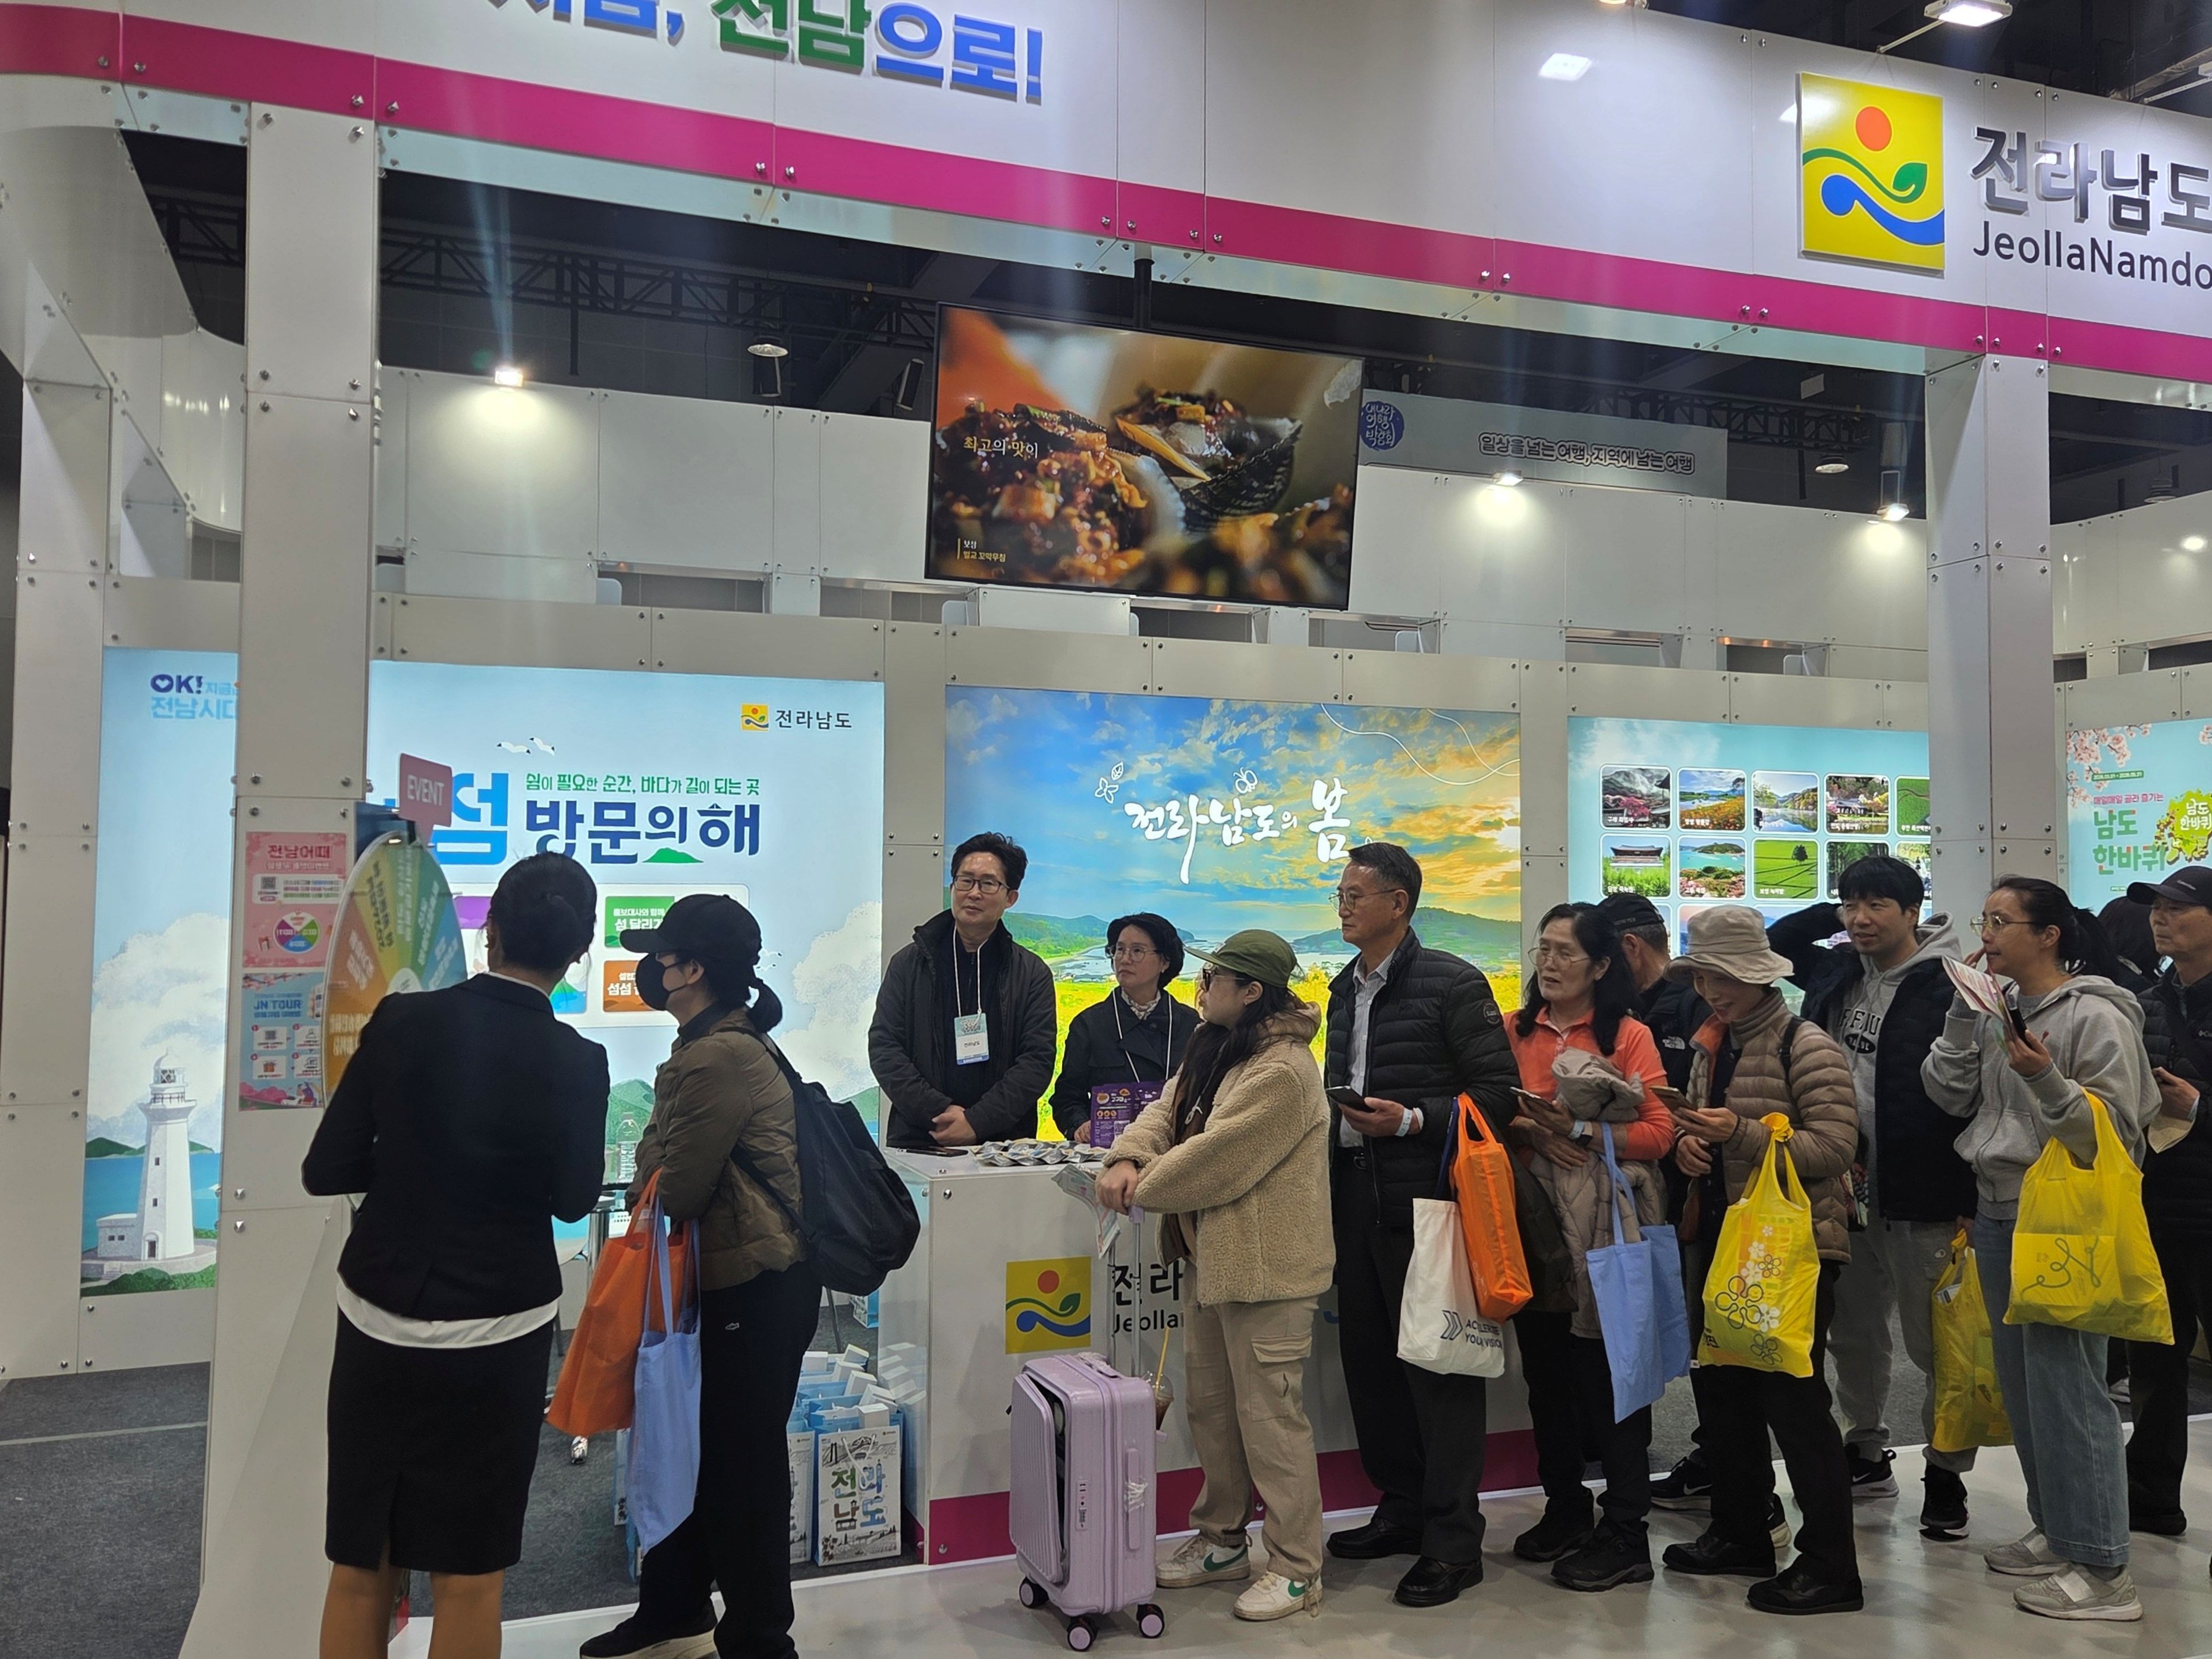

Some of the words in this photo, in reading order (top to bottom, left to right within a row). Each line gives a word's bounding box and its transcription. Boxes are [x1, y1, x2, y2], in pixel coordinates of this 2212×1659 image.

[711, 0, 1043, 101] 전남으로!
[1971, 125, 2212, 233] 전라남도
[1973, 220, 2212, 290] JeollaNamdo
[1366, 414, 1390, 429] 여행
[963, 435, 1007, 456] 최고의
[1011, 440, 1038, 459] 맛이
[1366, 422, 1396, 447] 박람회
[1481, 435, 1524, 455] 일상을
[1526, 439, 1556, 458] 넘는
[1557, 443, 1590, 464] 여행,
[1593, 447, 1634, 466] 지역에
[1636, 451, 1664, 469] 남는
[1666, 454, 1692, 472] 여행
[150, 674, 203, 695] OK!
[775, 709, 853, 730] 전라남도
[406, 774, 445, 809] EVENT
[526, 773, 552, 791] 쉼이
[557, 774, 598, 791] 필요한
[602, 775, 636, 795] 순간,
[641, 776, 682, 794] 바다가
[686, 777, 710, 794] 길이
[714, 778, 742, 796] 되는
[746, 778, 759, 796] 곳
[431, 772, 509, 866] 섬
[2185, 798, 2209, 816] 남도
[1123, 793, 1298, 885] 전라남도의
[1308, 777, 1352, 863] 봄
[2093, 809, 2138, 840] 남도
[2180, 817, 2212, 831] 한바퀴
[2092, 844, 2166, 875] 한바퀴
[614, 918, 627, 932] 섬
[1114, 1309, 1184, 1333] Jeolla
